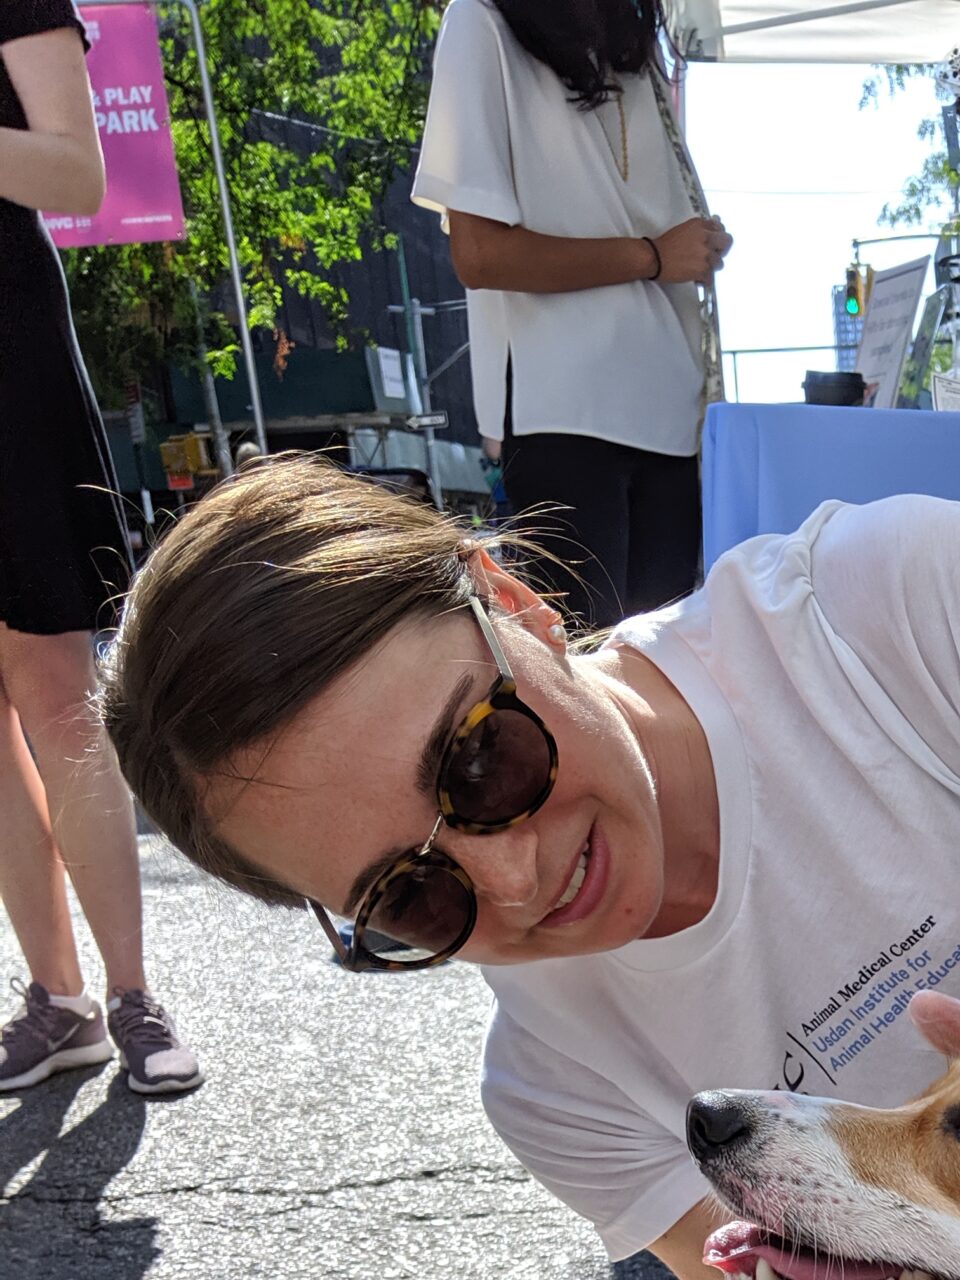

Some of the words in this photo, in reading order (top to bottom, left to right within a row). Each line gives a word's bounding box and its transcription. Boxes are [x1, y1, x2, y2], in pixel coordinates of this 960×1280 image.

[104, 86, 153, 106] PLAY
[800, 997, 842, 1038] Animal
[837, 951, 893, 1003] Medical
[889, 914, 938, 958] Center
[812, 1017, 856, 1054] Usdan
[849, 968, 911, 1022] Institute
[907, 950, 933, 973] for
[830, 1028, 874, 1073] Animal
[872, 989, 915, 1035] Health
